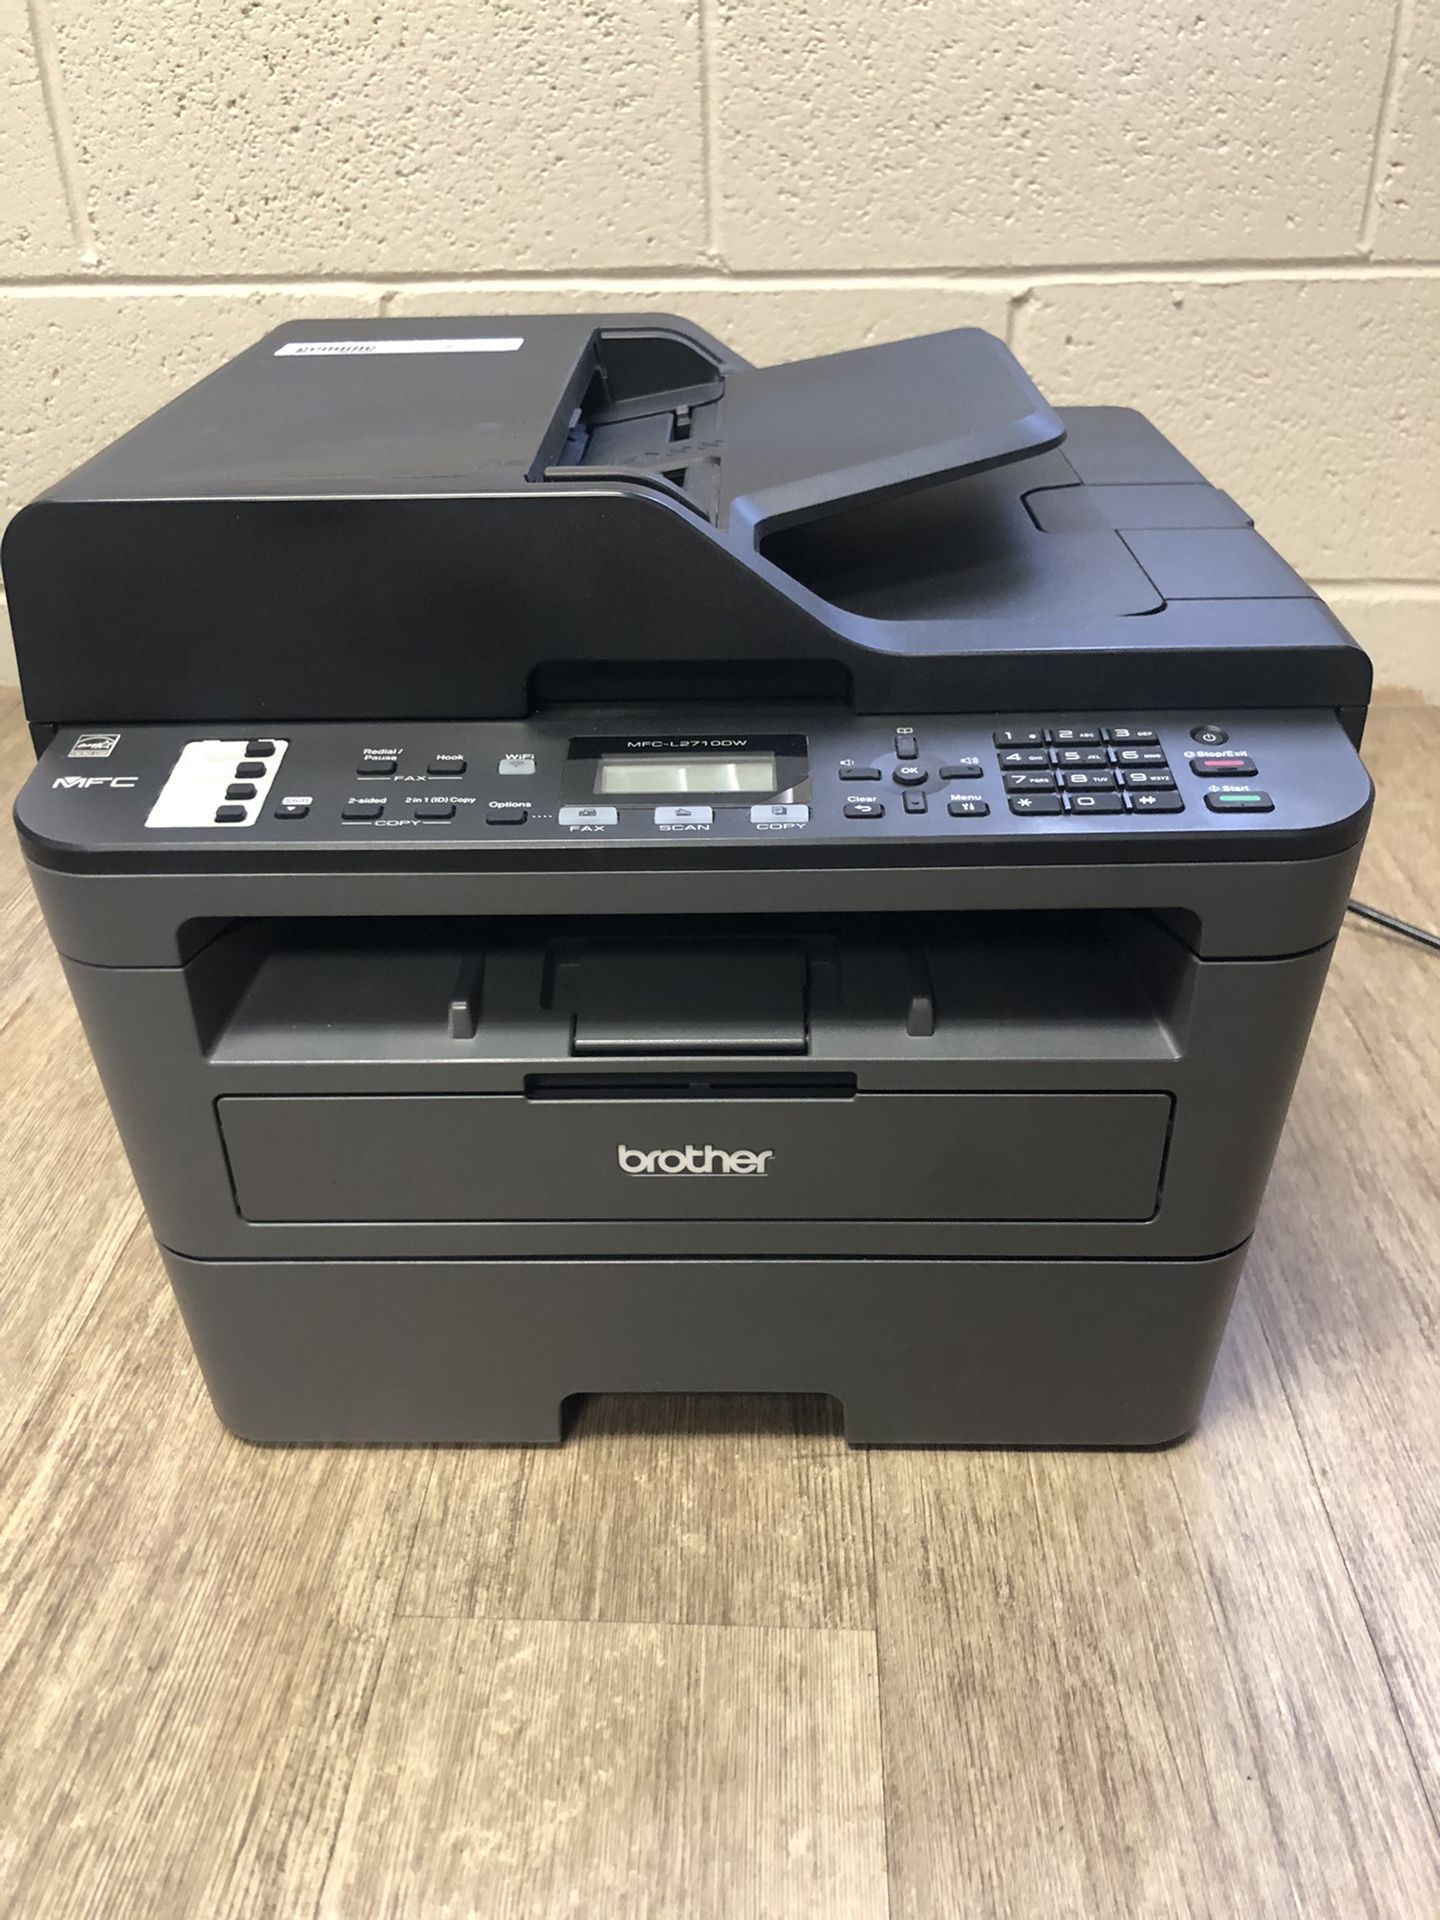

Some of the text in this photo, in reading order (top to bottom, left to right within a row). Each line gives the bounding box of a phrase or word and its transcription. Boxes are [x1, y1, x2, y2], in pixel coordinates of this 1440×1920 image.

[1059, 730, 1073, 738] 2
[1114, 729, 1130, 737] 3
[627, 740, 748, 748] MFC-L2710DW
[1006, 753, 1022, 761] 4
[1064, 752, 1080, 760] 5
[1122, 751, 1139, 759] 6
[1011, 775, 1026, 784] 7
[1070, 774, 1087, 783] 8
[1130, 773, 1147, 781] 9
[450, 796, 476, 804] Copy
[489, 801, 532, 809] Options
[618, 1144, 773, 1174] brother
